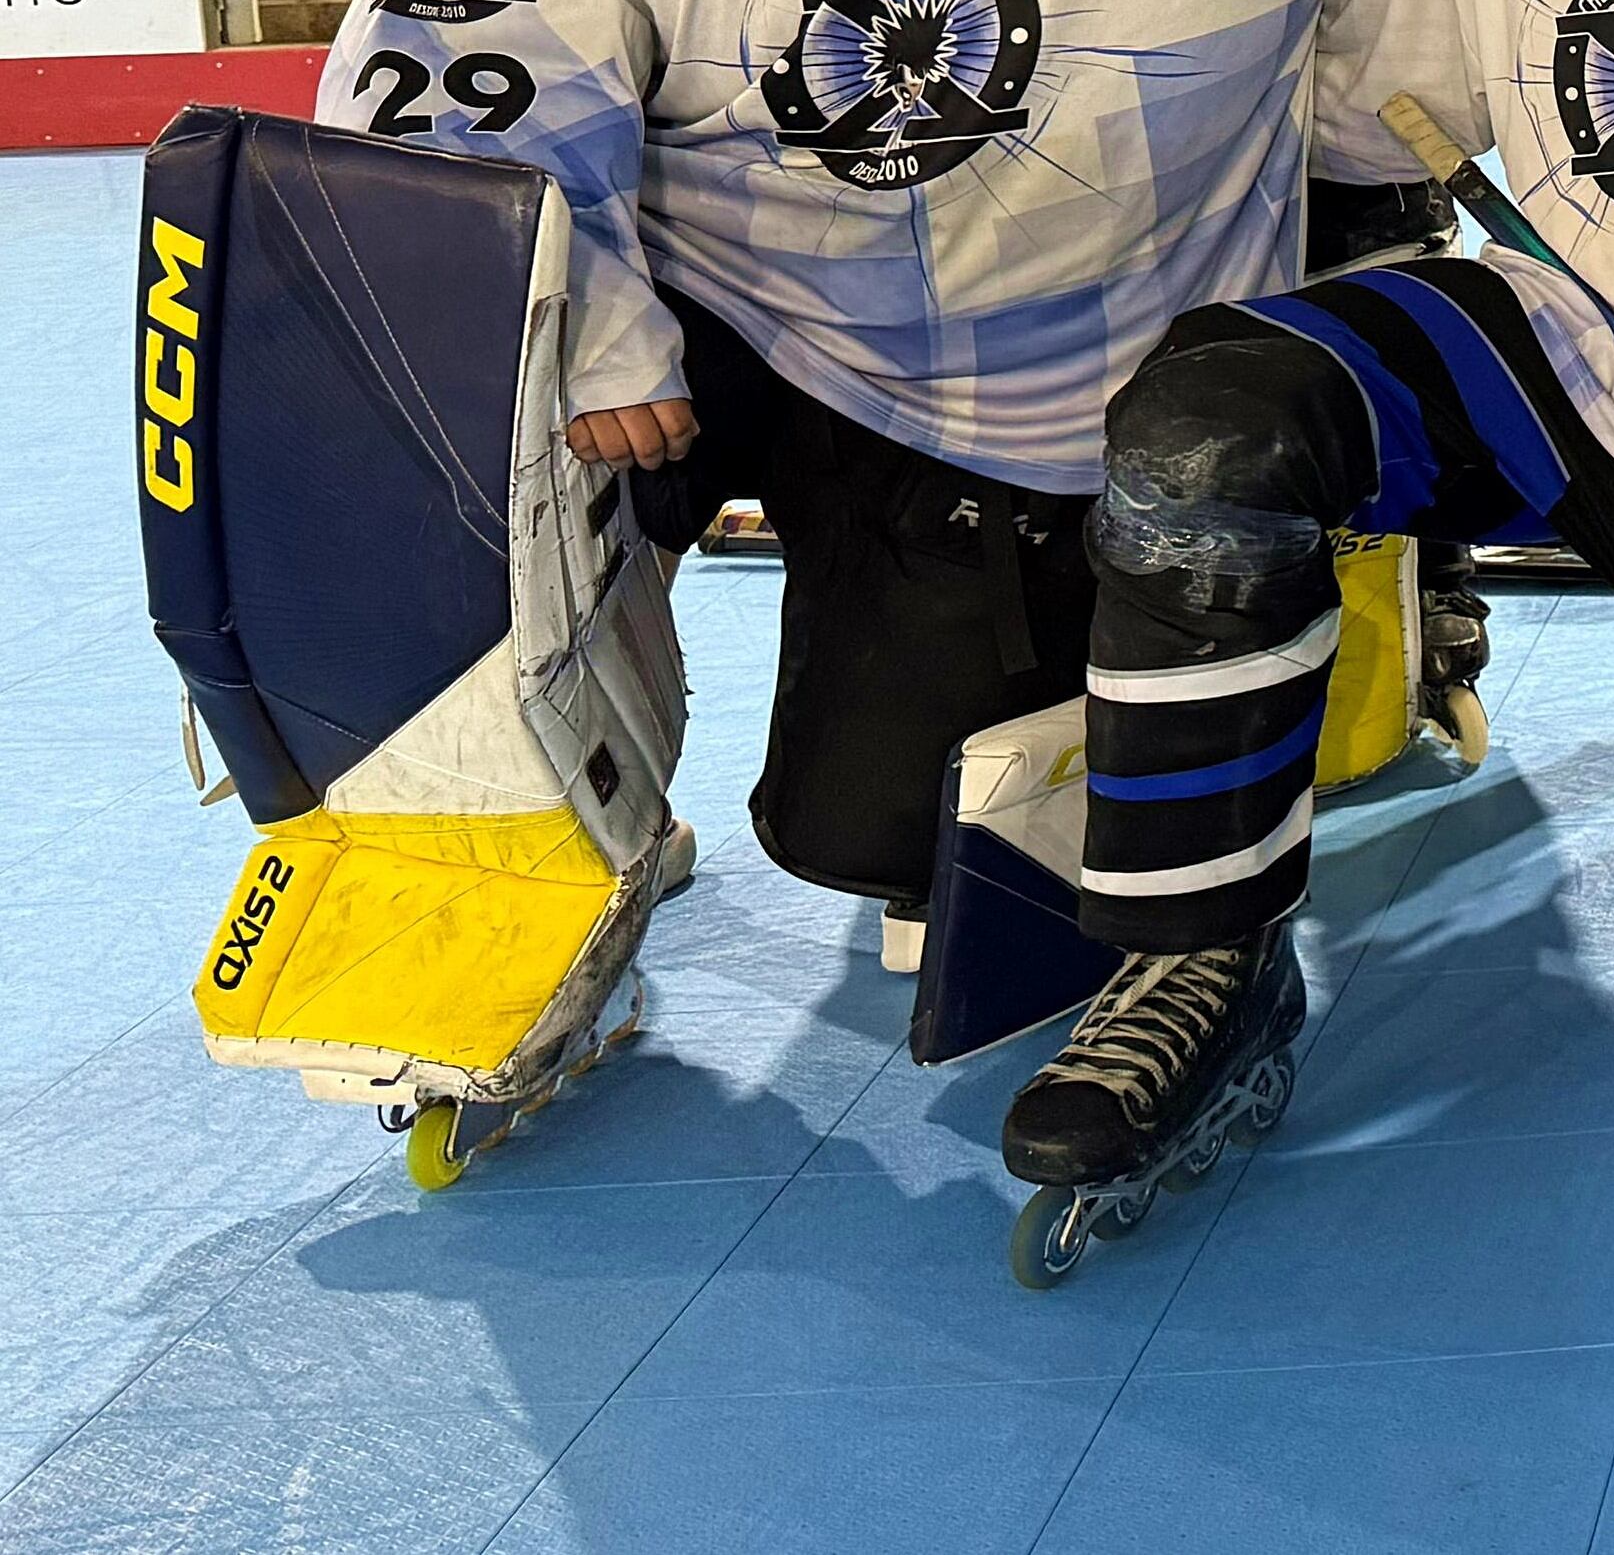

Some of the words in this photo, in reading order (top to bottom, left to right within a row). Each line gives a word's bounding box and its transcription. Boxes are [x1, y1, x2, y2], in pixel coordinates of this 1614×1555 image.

[352, 49, 538, 135] 29
[875, 155, 919, 181] 2010
[144, 215, 205, 514] CCM
[261, 854, 295, 895] 2
